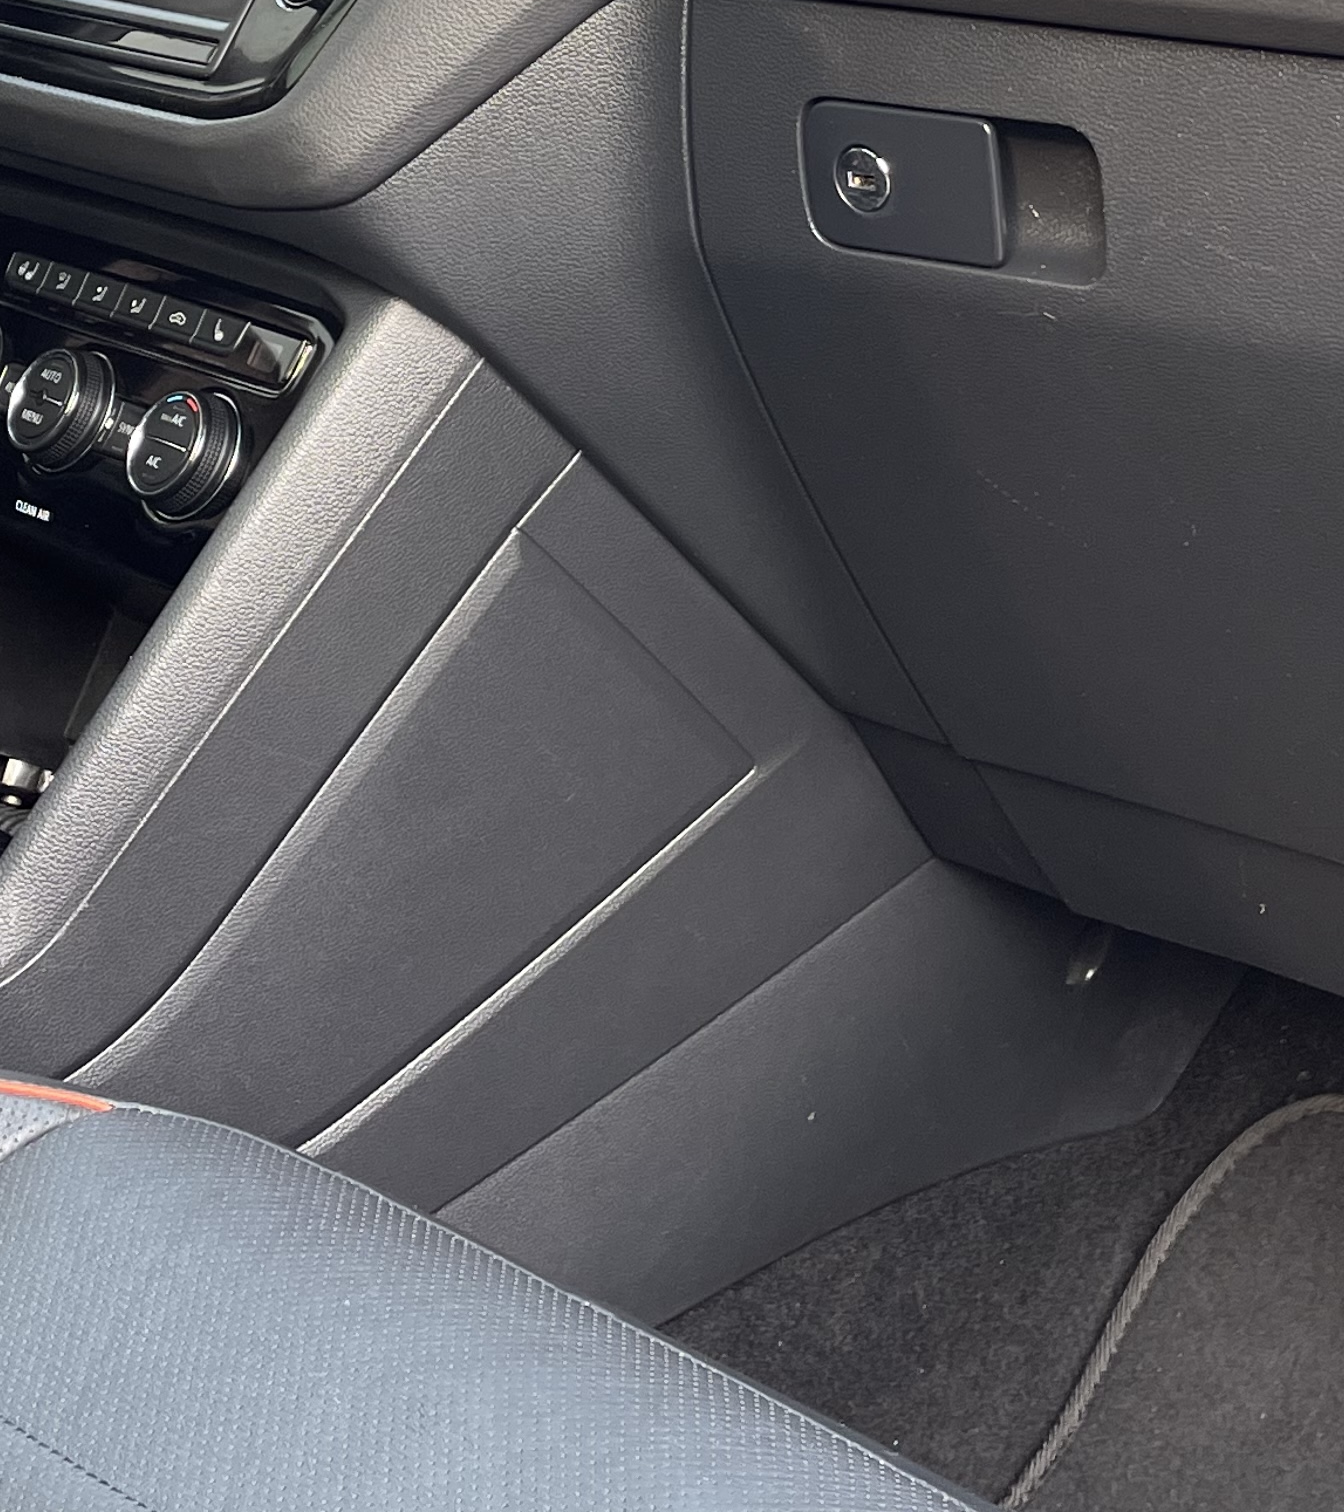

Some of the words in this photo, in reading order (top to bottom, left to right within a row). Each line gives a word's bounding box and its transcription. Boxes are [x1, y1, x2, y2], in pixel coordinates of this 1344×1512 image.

[40, 368, 63, 384] AUTO
[21, 408, 44, 425] MENU
[15, 499, 38, 518] CLEAN
[37, 508, 51, 522] AIR
